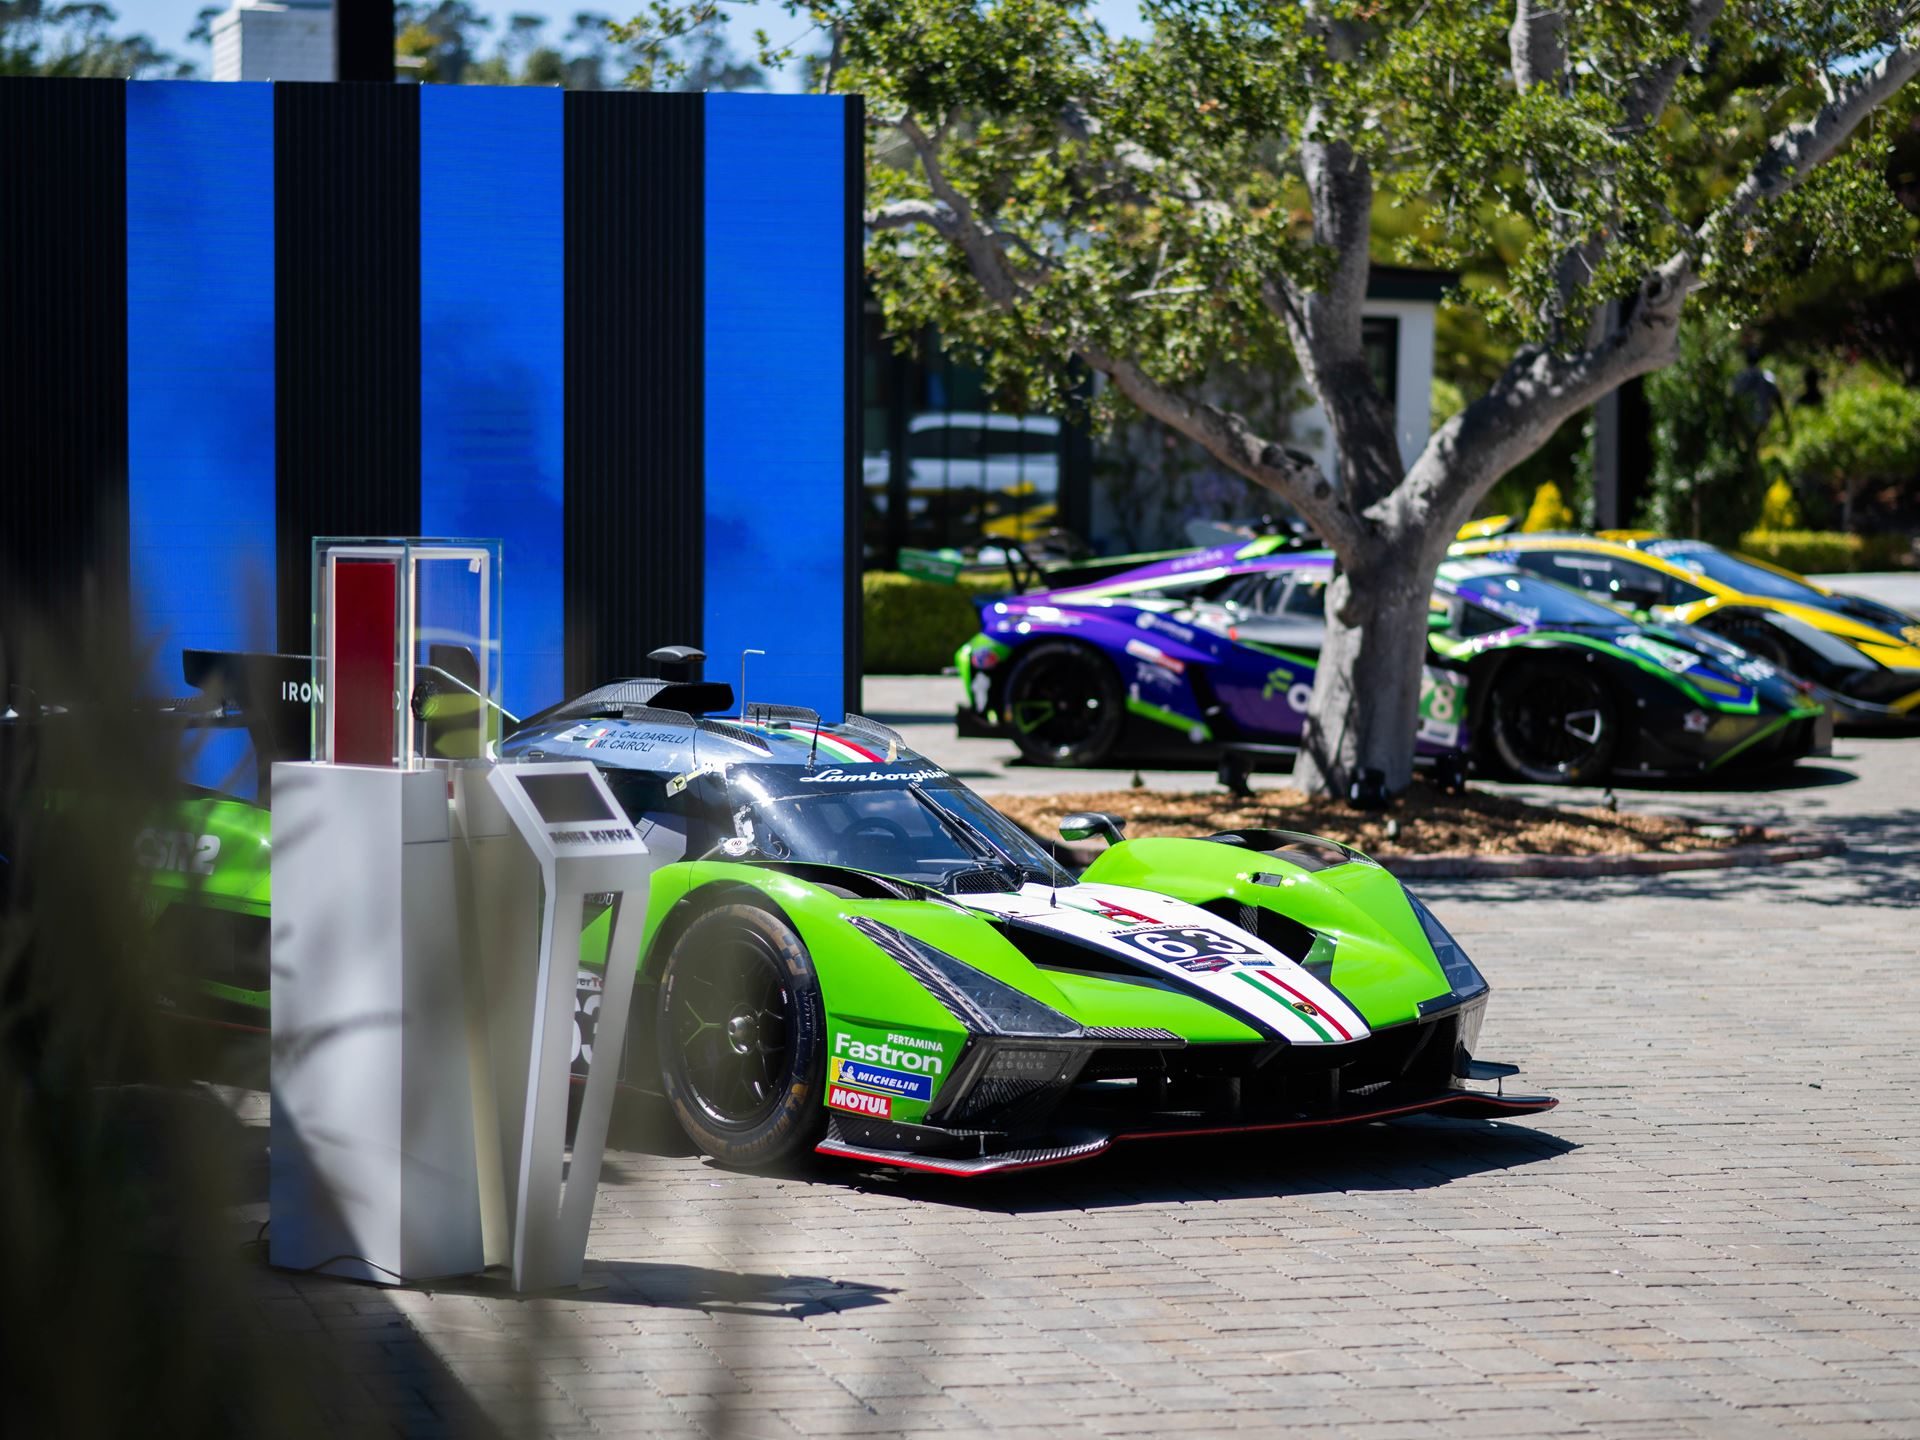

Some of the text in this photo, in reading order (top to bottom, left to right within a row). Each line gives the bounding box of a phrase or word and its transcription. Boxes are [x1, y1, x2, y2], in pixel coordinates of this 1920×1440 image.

[282, 681, 324, 704] IRON
[609, 739, 656, 753] CAIROLI
[619, 730, 689, 745] CALDARELLI
[1133, 929, 1247, 958] 63
[835, 1032, 943, 1074] Fastron
[887, 1033, 944, 1053] PERTAMINA
[857, 1071, 920, 1092] MICHELIN
[831, 1088, 889, 1116] MOTUL
